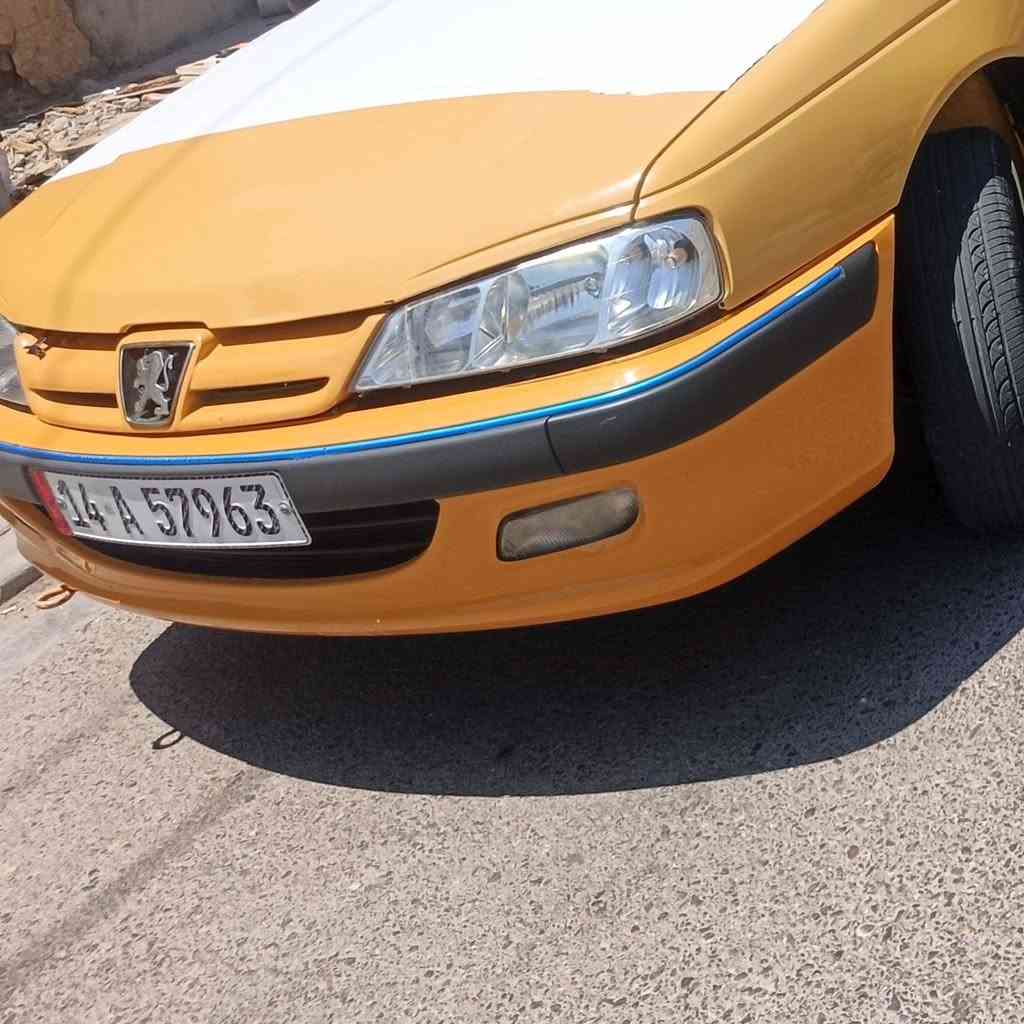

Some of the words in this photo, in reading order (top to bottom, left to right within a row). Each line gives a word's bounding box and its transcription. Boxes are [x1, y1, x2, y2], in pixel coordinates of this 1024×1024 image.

[57, 479, 107, 531] 14
[109, 485, 144, 535] A
[140, 483, 281, 538] 57963
